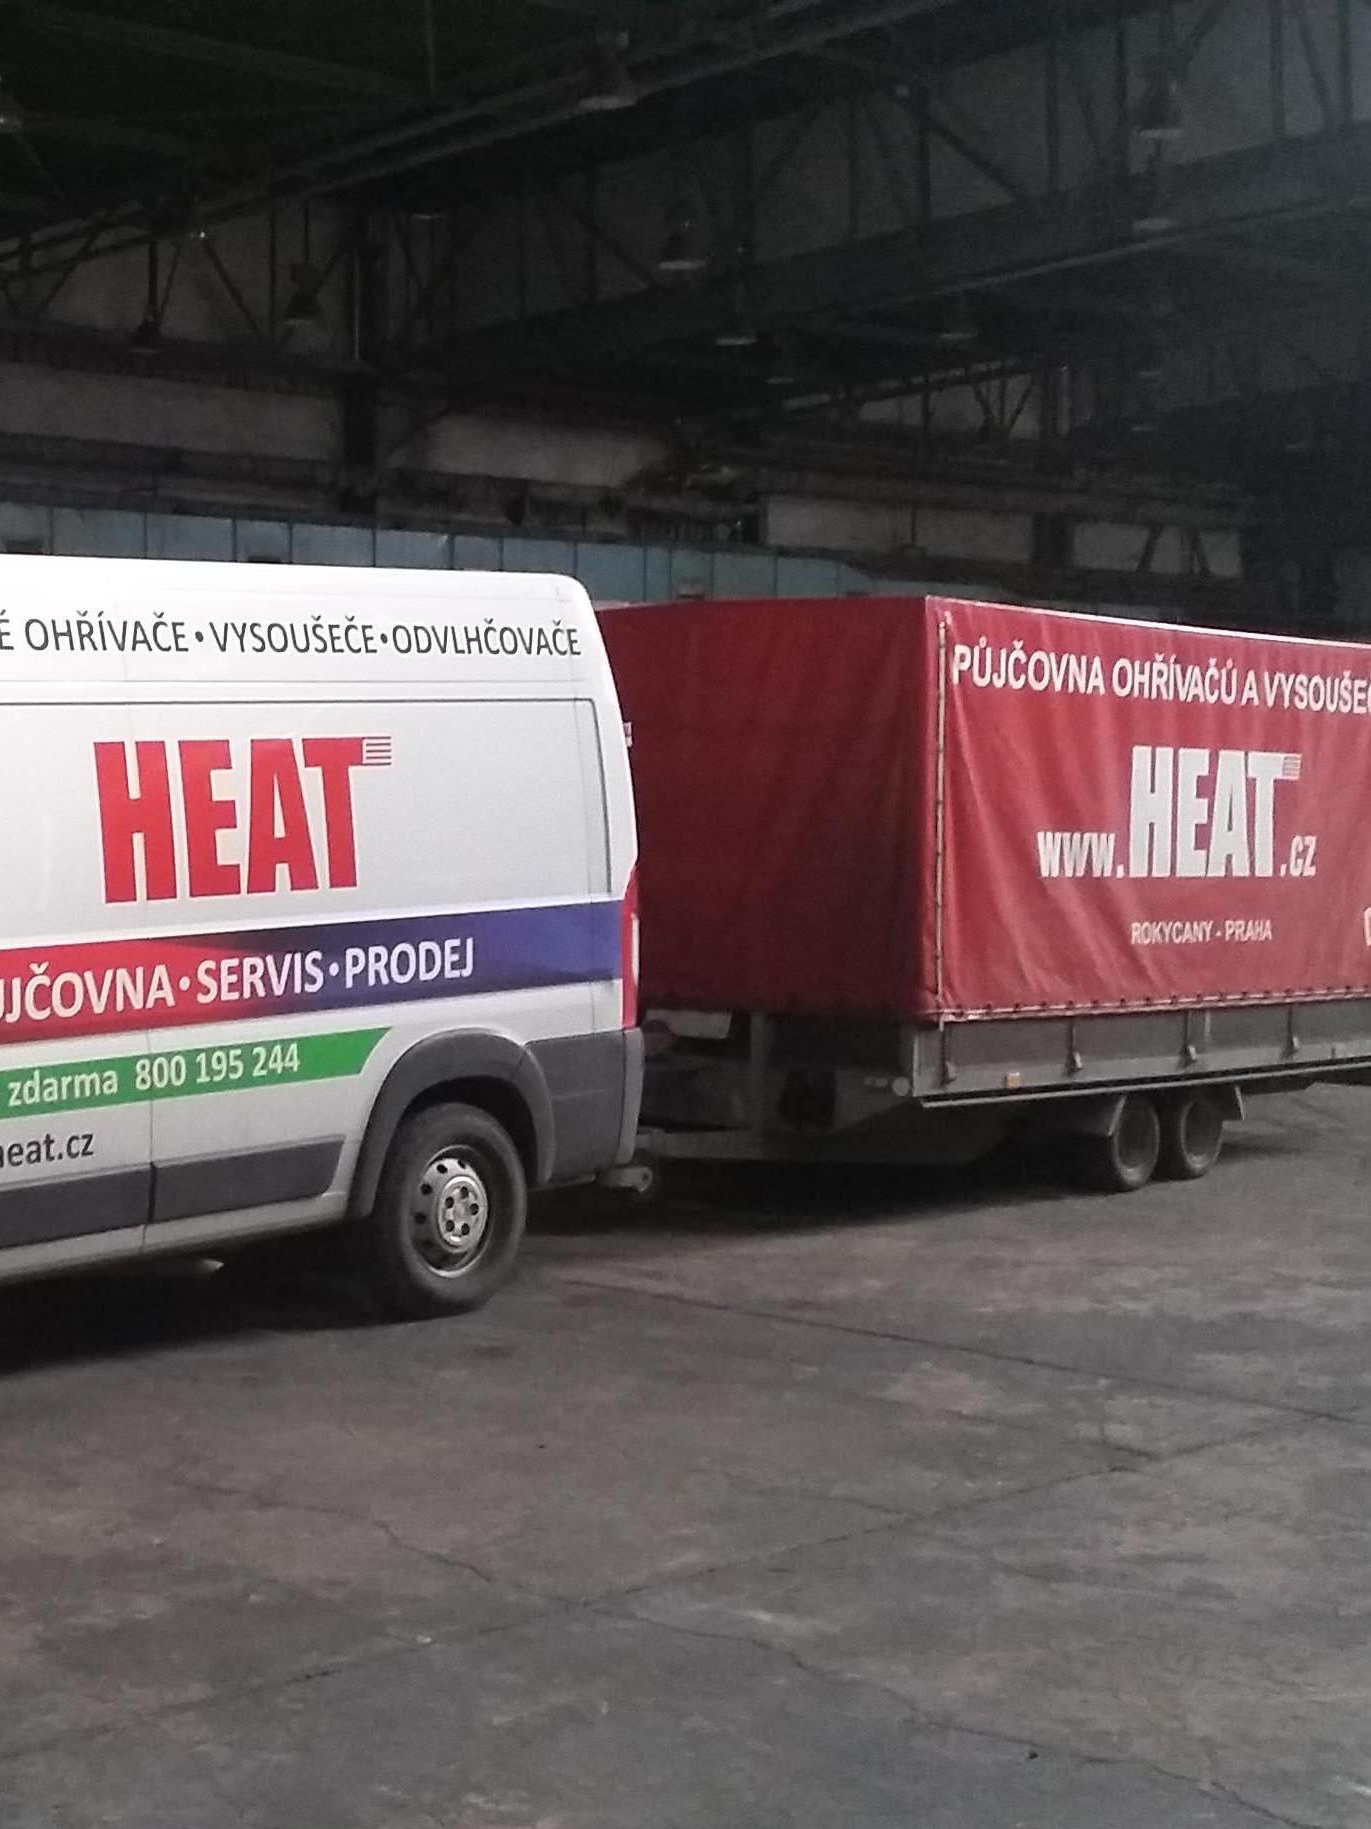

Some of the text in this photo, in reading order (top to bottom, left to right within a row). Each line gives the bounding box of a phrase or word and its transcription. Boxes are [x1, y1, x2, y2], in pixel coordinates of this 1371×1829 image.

[23, 609, 189, 652] OHŘÍVAČE
[209, 614, 378, 655] VYSOUŠEČE
[391, 617, 582, 656] ODVLHČOVAČE
[951, 635, 1371, 715] PŮJČOVNA OHŘÍVAČŮ A VYSOUŠE
[93, 736, 392, 904] HEAT
[1130, 919, 1214, 945] ROKYCANY
[1224, 919, 1273, 942] PRAHA
[196, 950, 324, 1004] SERVIS
[344, 937, 475, 989] PRODEJ
[8, 1067, 118, 1106] zdarma
[134, 1053, 187, 1090] 800
[196, 1048, 244, 1082] 195
[252, 1042, 301, 1077] 244
